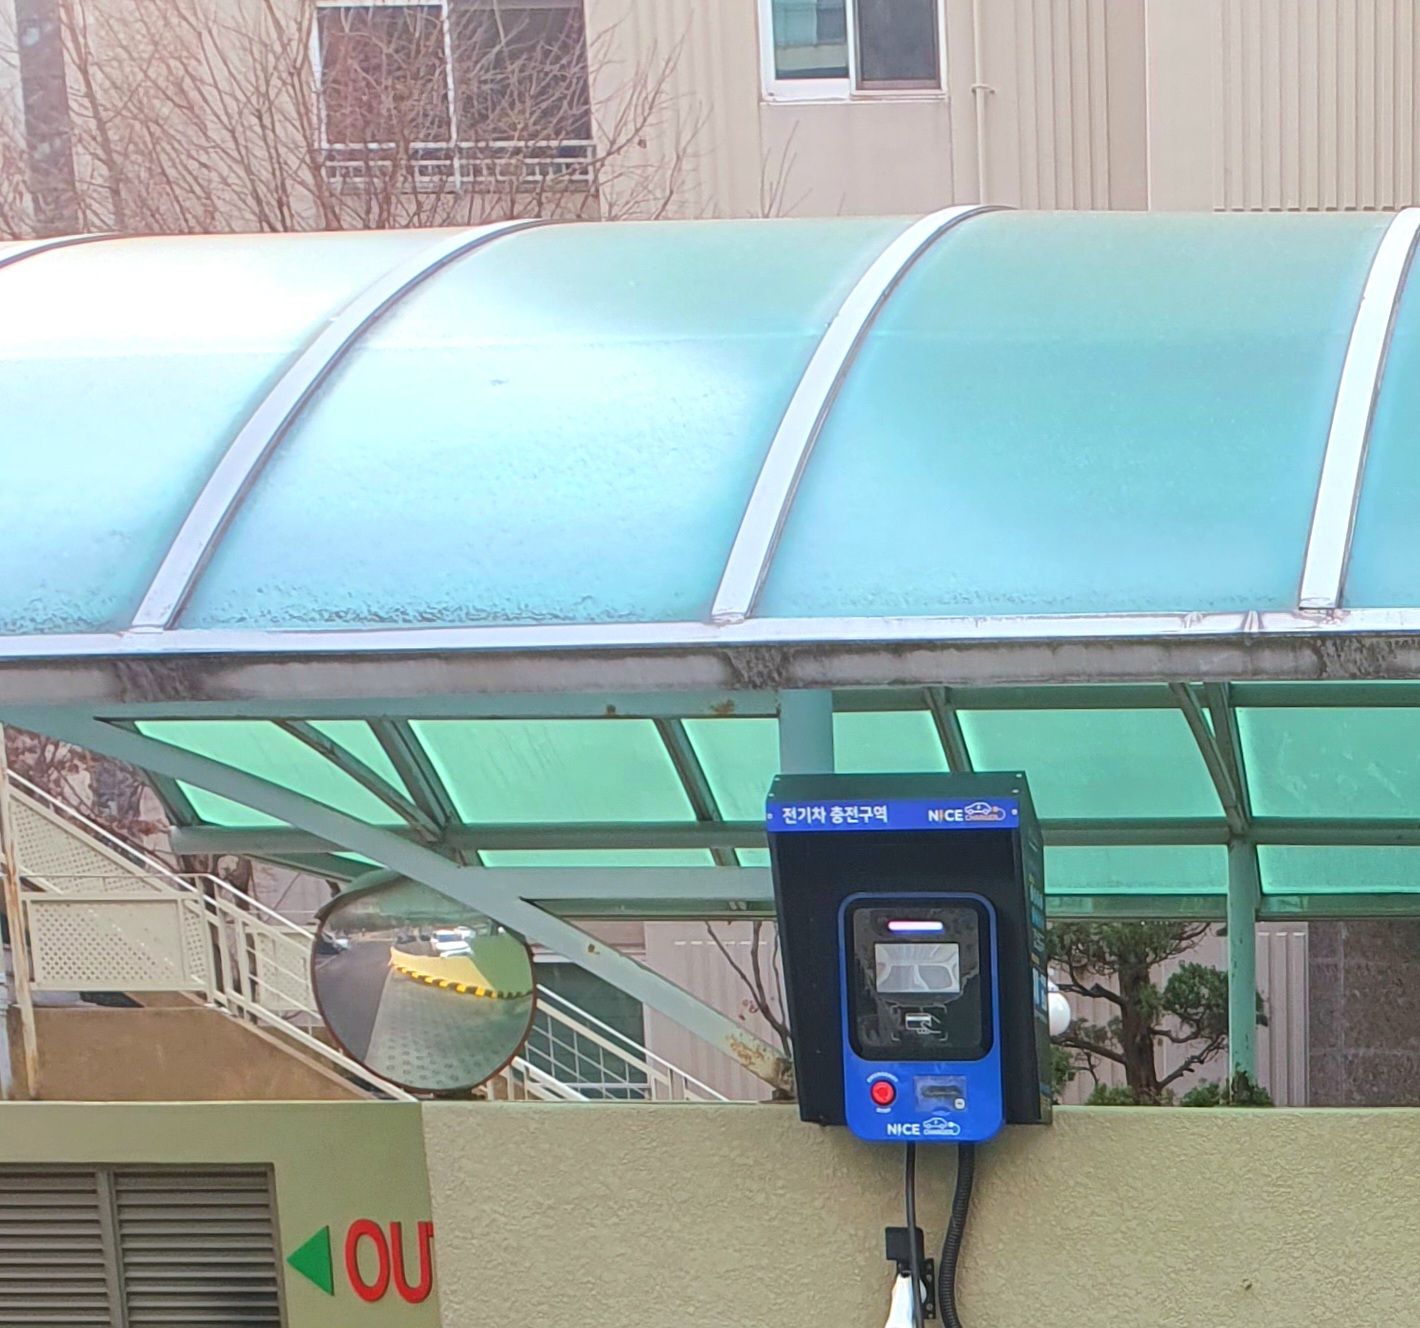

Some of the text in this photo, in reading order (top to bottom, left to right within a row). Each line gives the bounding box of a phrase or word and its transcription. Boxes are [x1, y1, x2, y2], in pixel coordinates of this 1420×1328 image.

[782, 805, 888, 824] 전기차 충전구역
[928, 809, 964, 822] NICE
[887, 1123, 921, 1137] NICE
